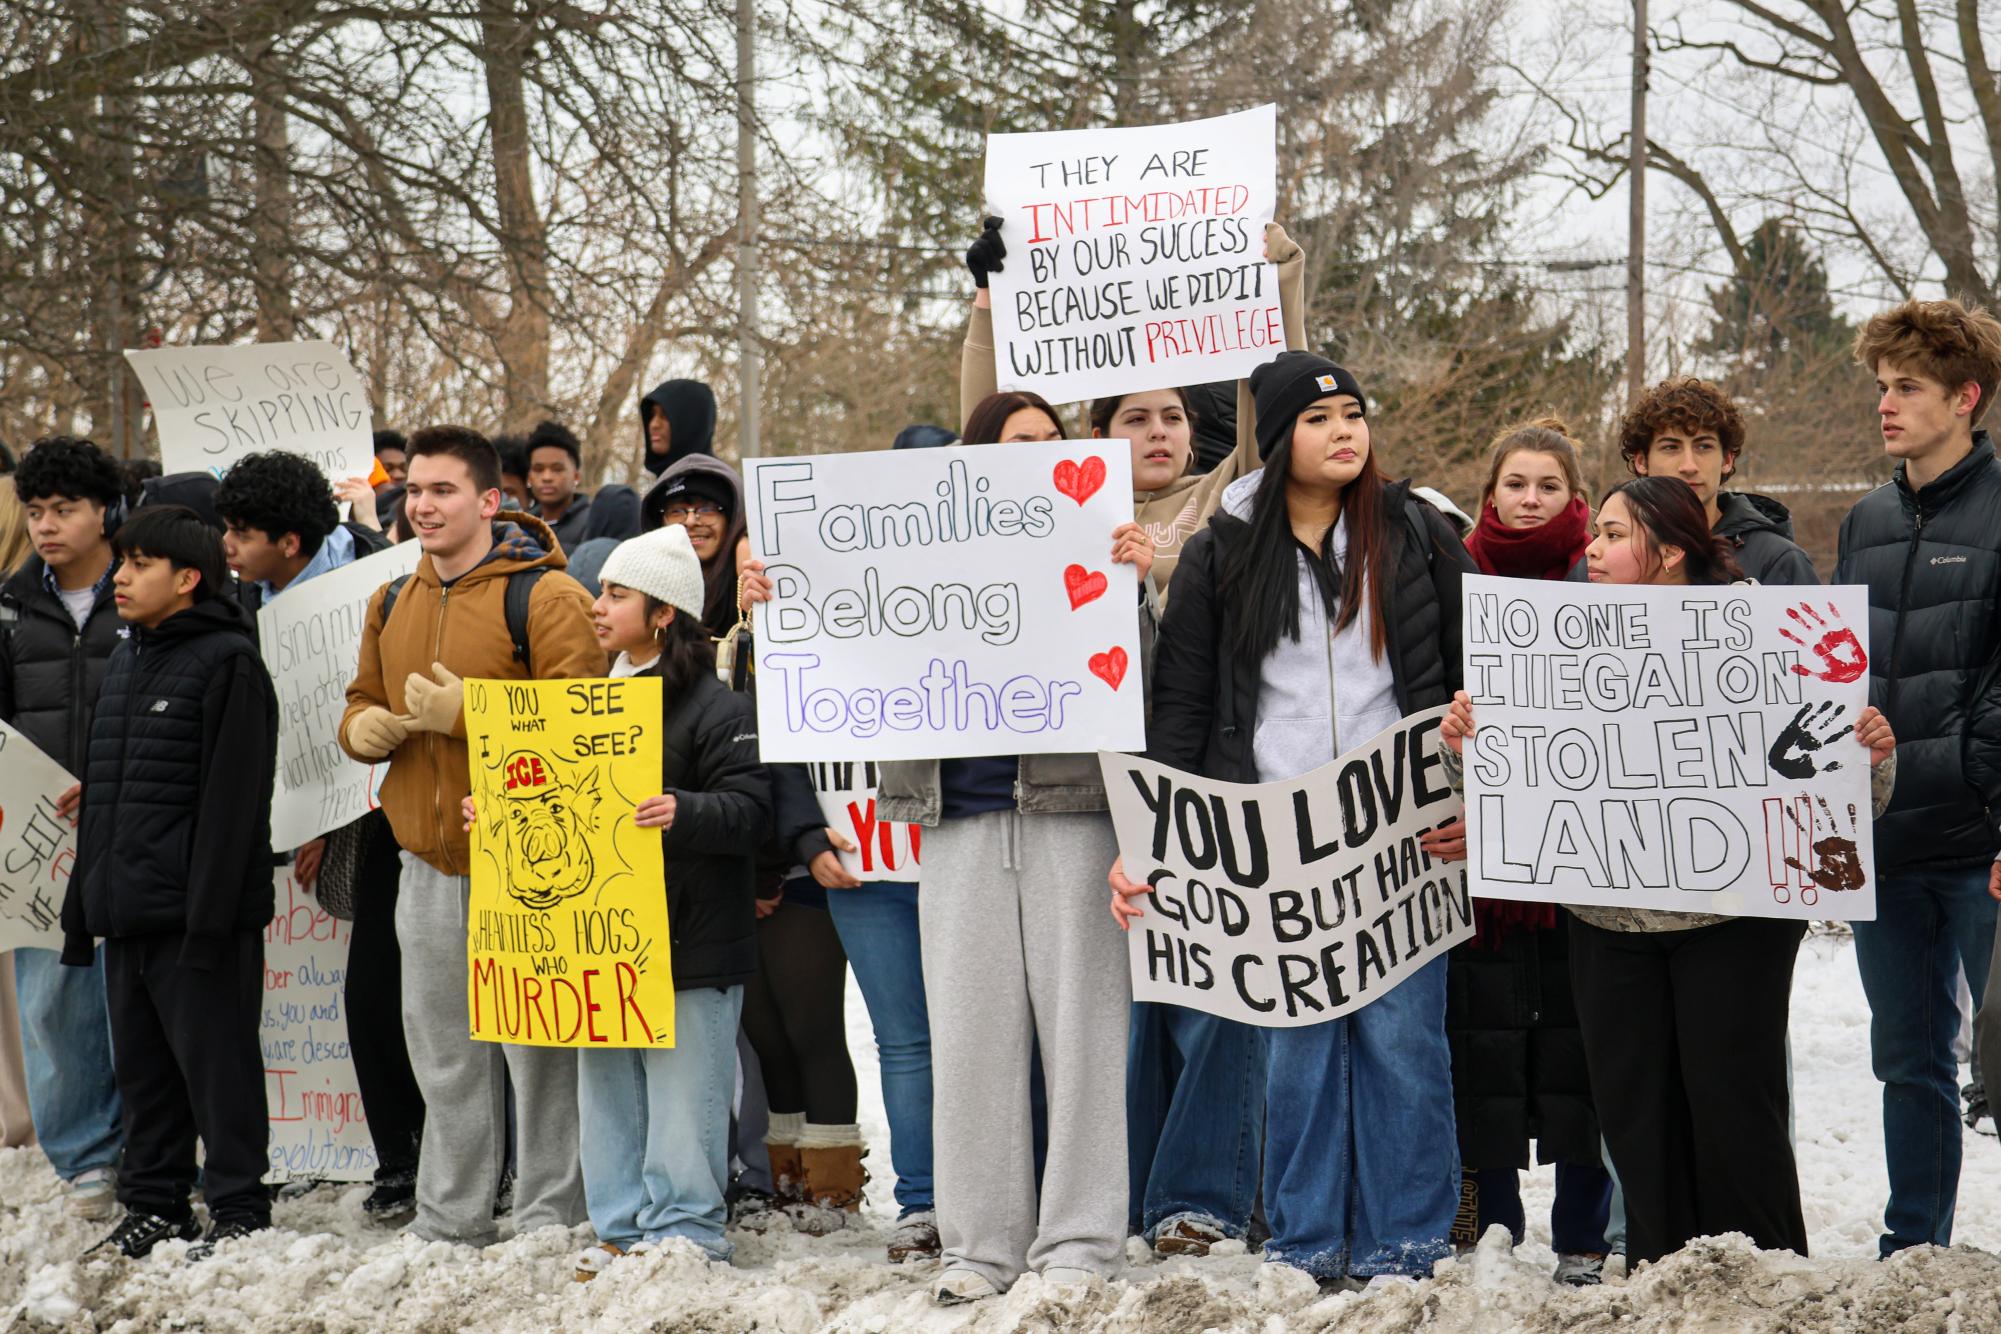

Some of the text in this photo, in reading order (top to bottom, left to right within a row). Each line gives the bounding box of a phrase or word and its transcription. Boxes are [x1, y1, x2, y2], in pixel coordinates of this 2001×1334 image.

[1029, 149, 1209, 188] THEY ARE
[1021, 185, 1249, 243] INTIMIDATED
[1030, 217, 1249, 284] BY OUR SUCCESS
[1015, 280, 1140, 332] BECAUSE
[1146, 275, 1182, 311] WE
[1009, 307, 1282, 377] WITHOUT PRIVILEGE
[154, 361, 341, 408] We are
[194, 392, 361, 454] SKIPPING
[757, 459, 1054, 556] Families
[764, 563, 1020, 646] Belong
[1469, 593, 1753, 652] NO ONE IS
[470, 682, 625, 716] DO YOU SEE
[511, 718, 546, 733] WHAT
[763, 653, 1082, 738] Together
[480, 725, 643, 758] I SEE?
[1473, 711, 1769, 791] STOLEN
[506, 756, 547, 790] ICE
[1127, 716, 1452, 889] YOU LOVE
[478, 908, 640, 955] HEARTLESS HOGS
[1147, 869, 1250, 938] GOD
[1270, 864, 1364, 943] BUT
[531, 955, 568, 976] WHO
[1146, 869, 1472, 1017] HIS CREATION
[473, 957, 654, 1044] MURDER
